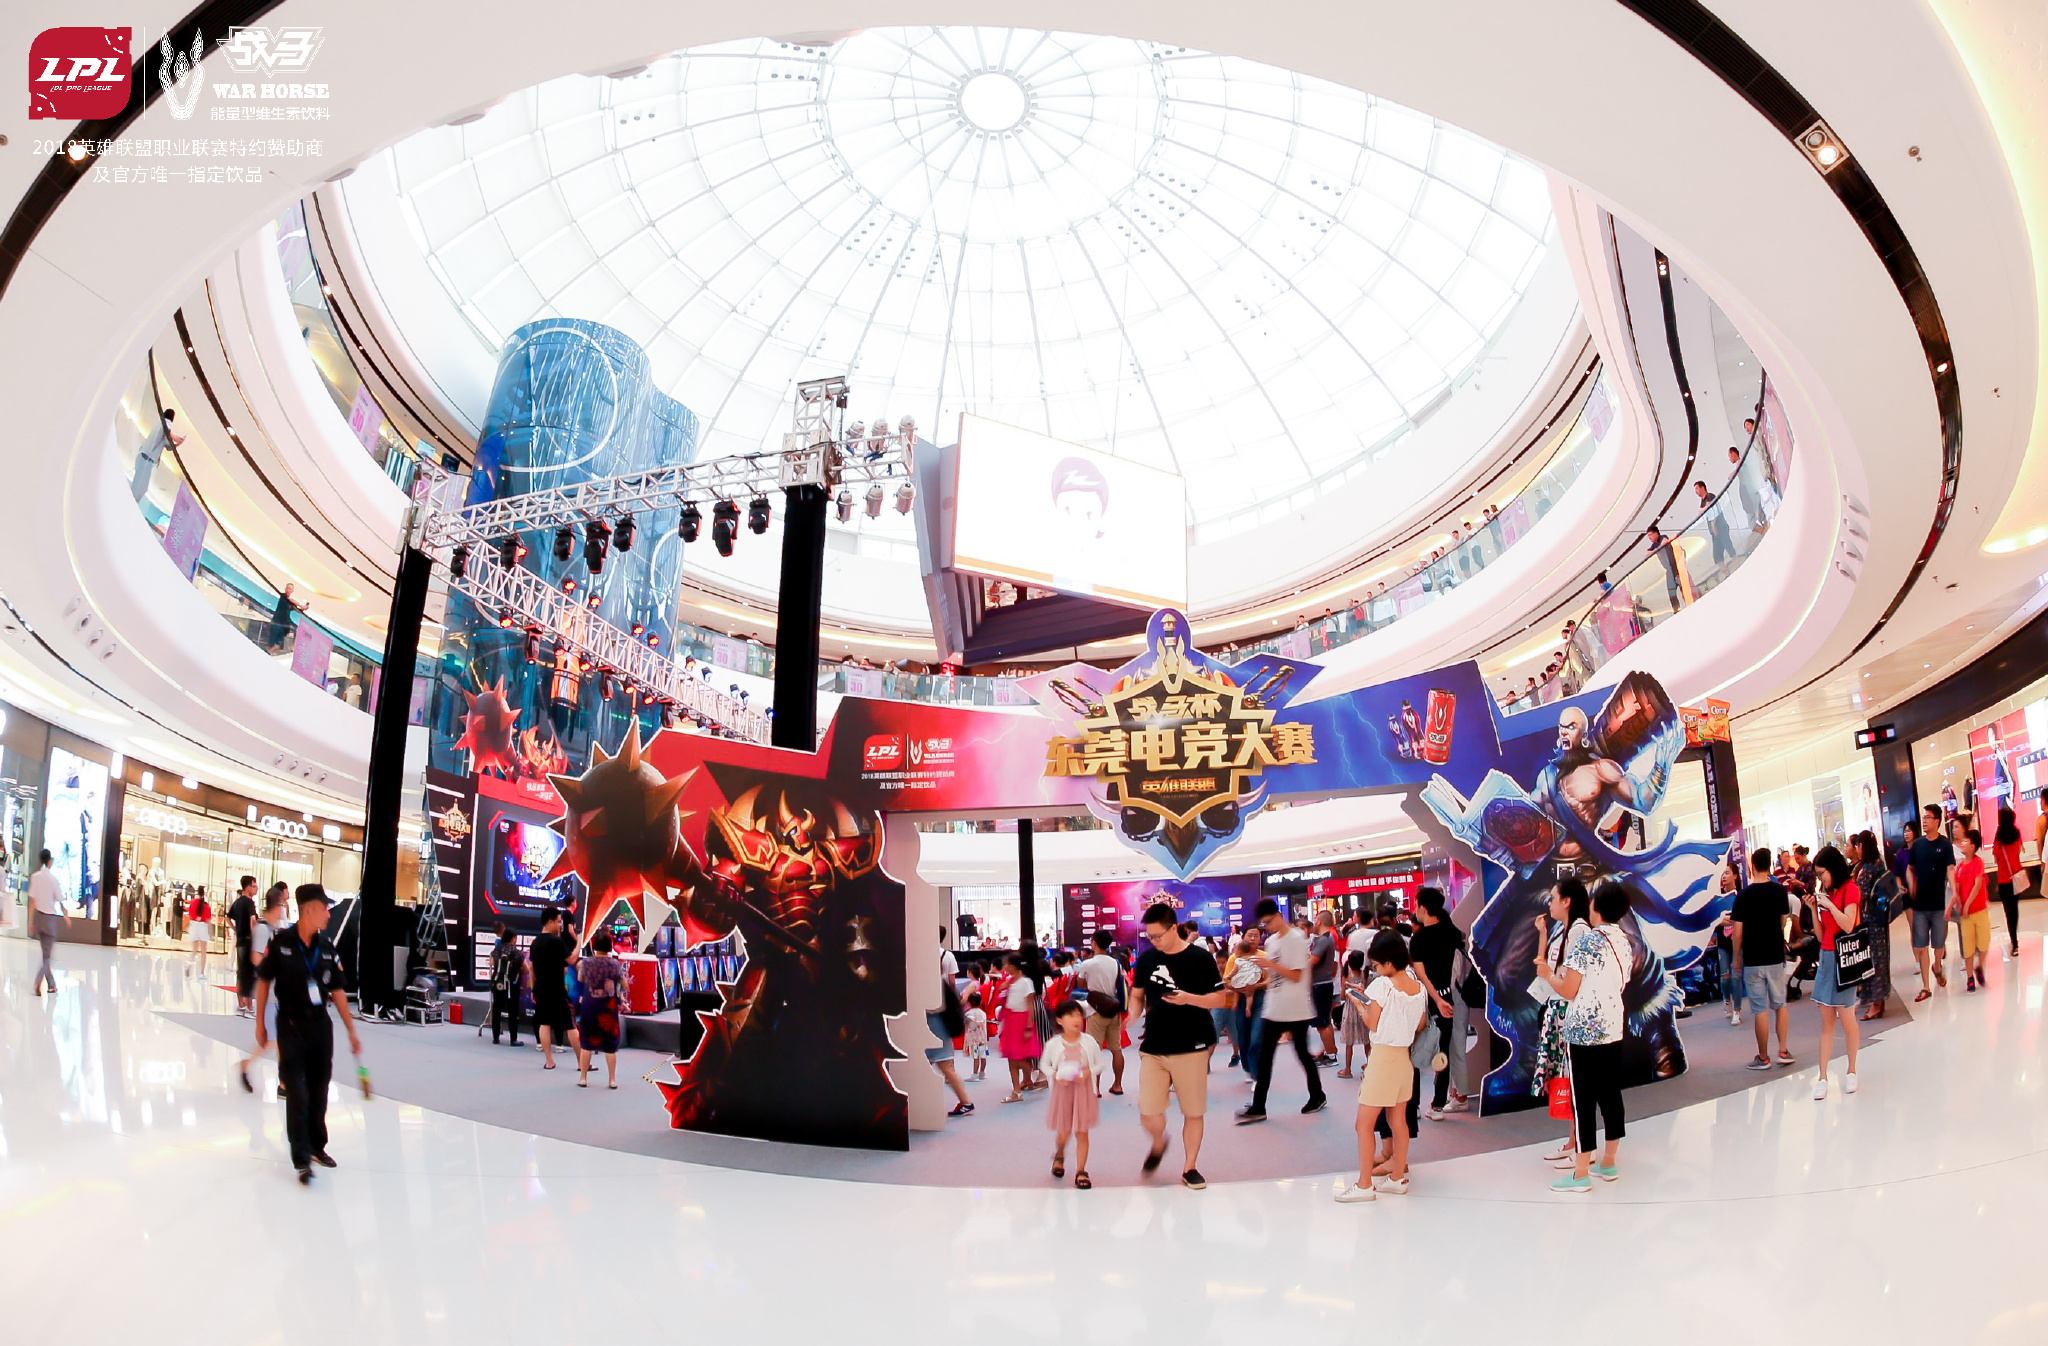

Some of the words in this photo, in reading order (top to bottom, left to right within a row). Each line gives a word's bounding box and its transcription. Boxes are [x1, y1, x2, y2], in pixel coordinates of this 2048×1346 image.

[1127, 693, 1222, 721] 战马杯
[866, 745, 900, 757] LPL
[1044, 721, 1318, 776] 东莞电竞大赛
[1141, 776, 1216, 793] 英雄联盟
[1301, 869, 1331, 880] LONDON
[1839, 939, 1860, 956] Juter
[1840, 945, 1871, 968] Einkauf
